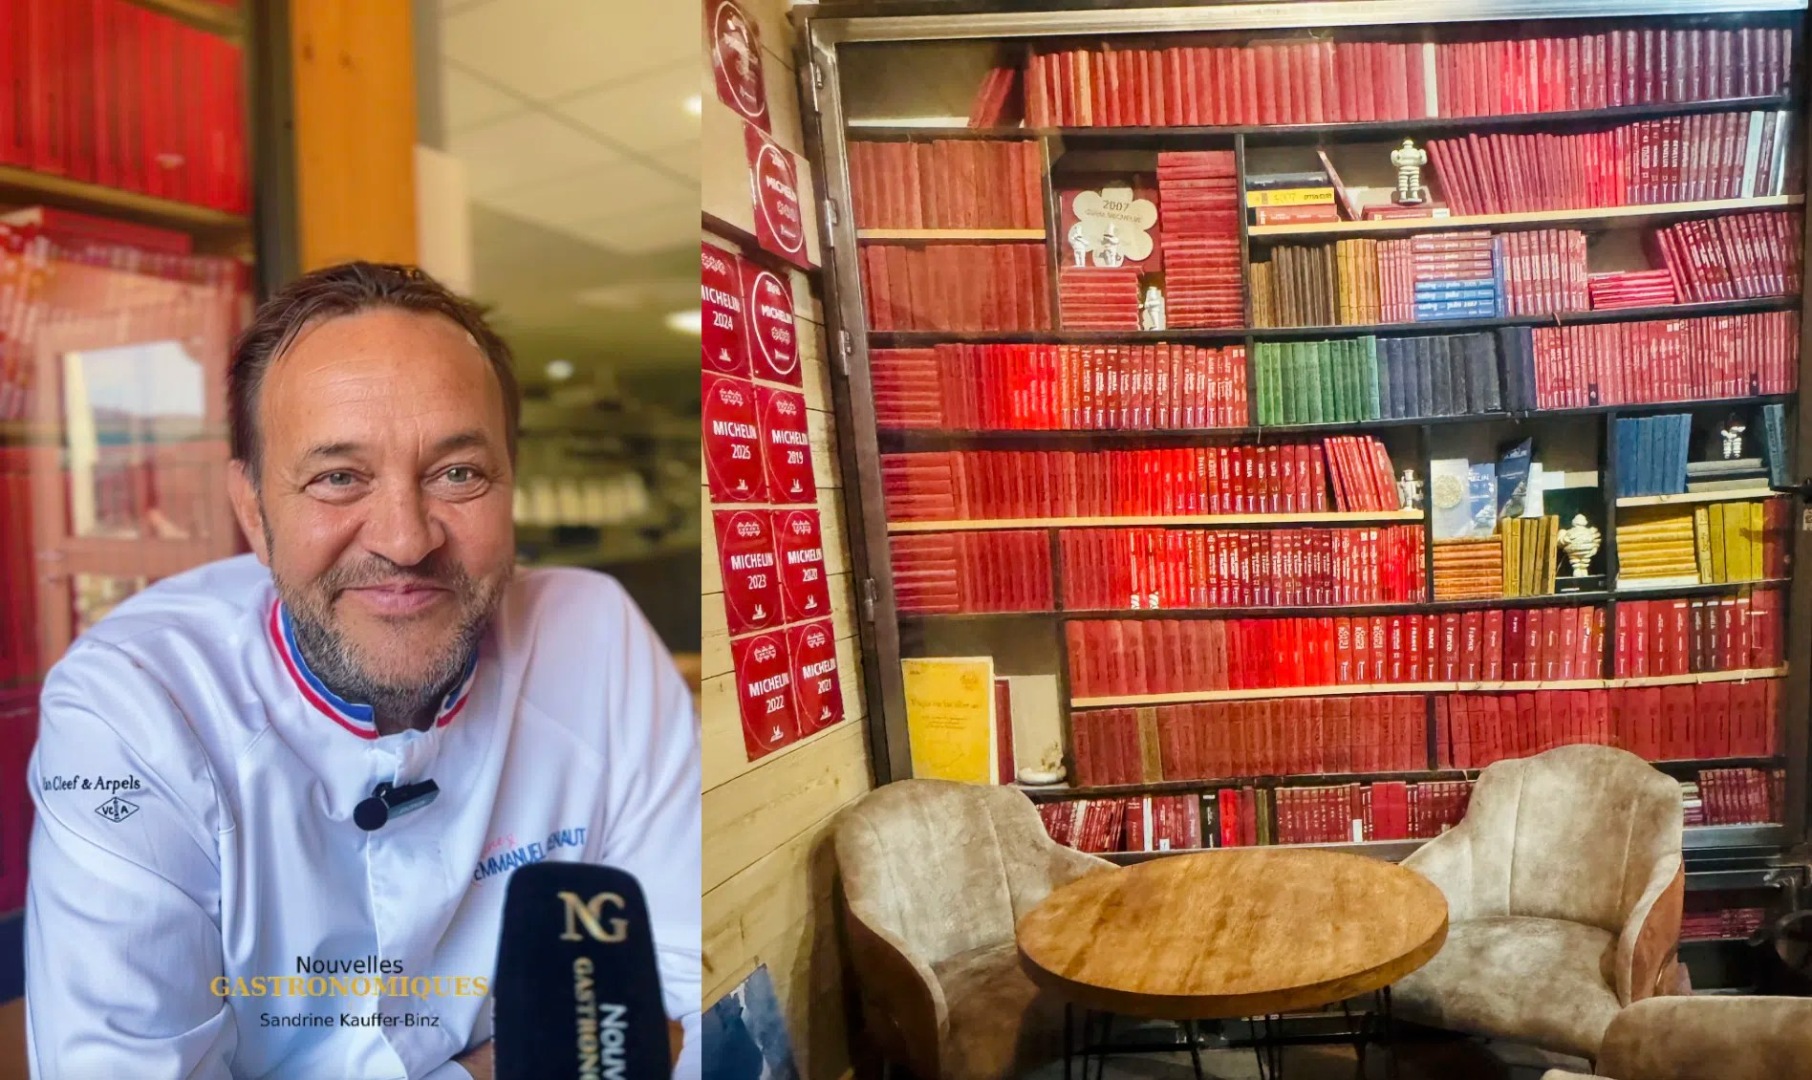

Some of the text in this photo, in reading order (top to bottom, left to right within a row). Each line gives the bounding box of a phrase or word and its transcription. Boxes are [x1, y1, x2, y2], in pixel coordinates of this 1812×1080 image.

[1102, 199, 1130, 212] 2007
[712, 311, 734, 331] 2024
[712, 420, 758, 440] MICHELIN
[771, 429, 809, 446] MICHELIN
[730, 552, 774, 571] MICHELIN
[787, 548, 823, 565] MICHELIN
[747, 574, 767, 590] 2023
[802, 658, 837, 679] MICHELIN
[748, 672, 790, 698] MICHELIN
[766, 695, 785, 714] 2022
[53, 775, 80, 791] Cleef
[81, 778, 92, 790] &
[94, 774, 140, 794] Arpels
[546, 827, 586, 852] ENAUT
[557, 890, 629, 942] NG
